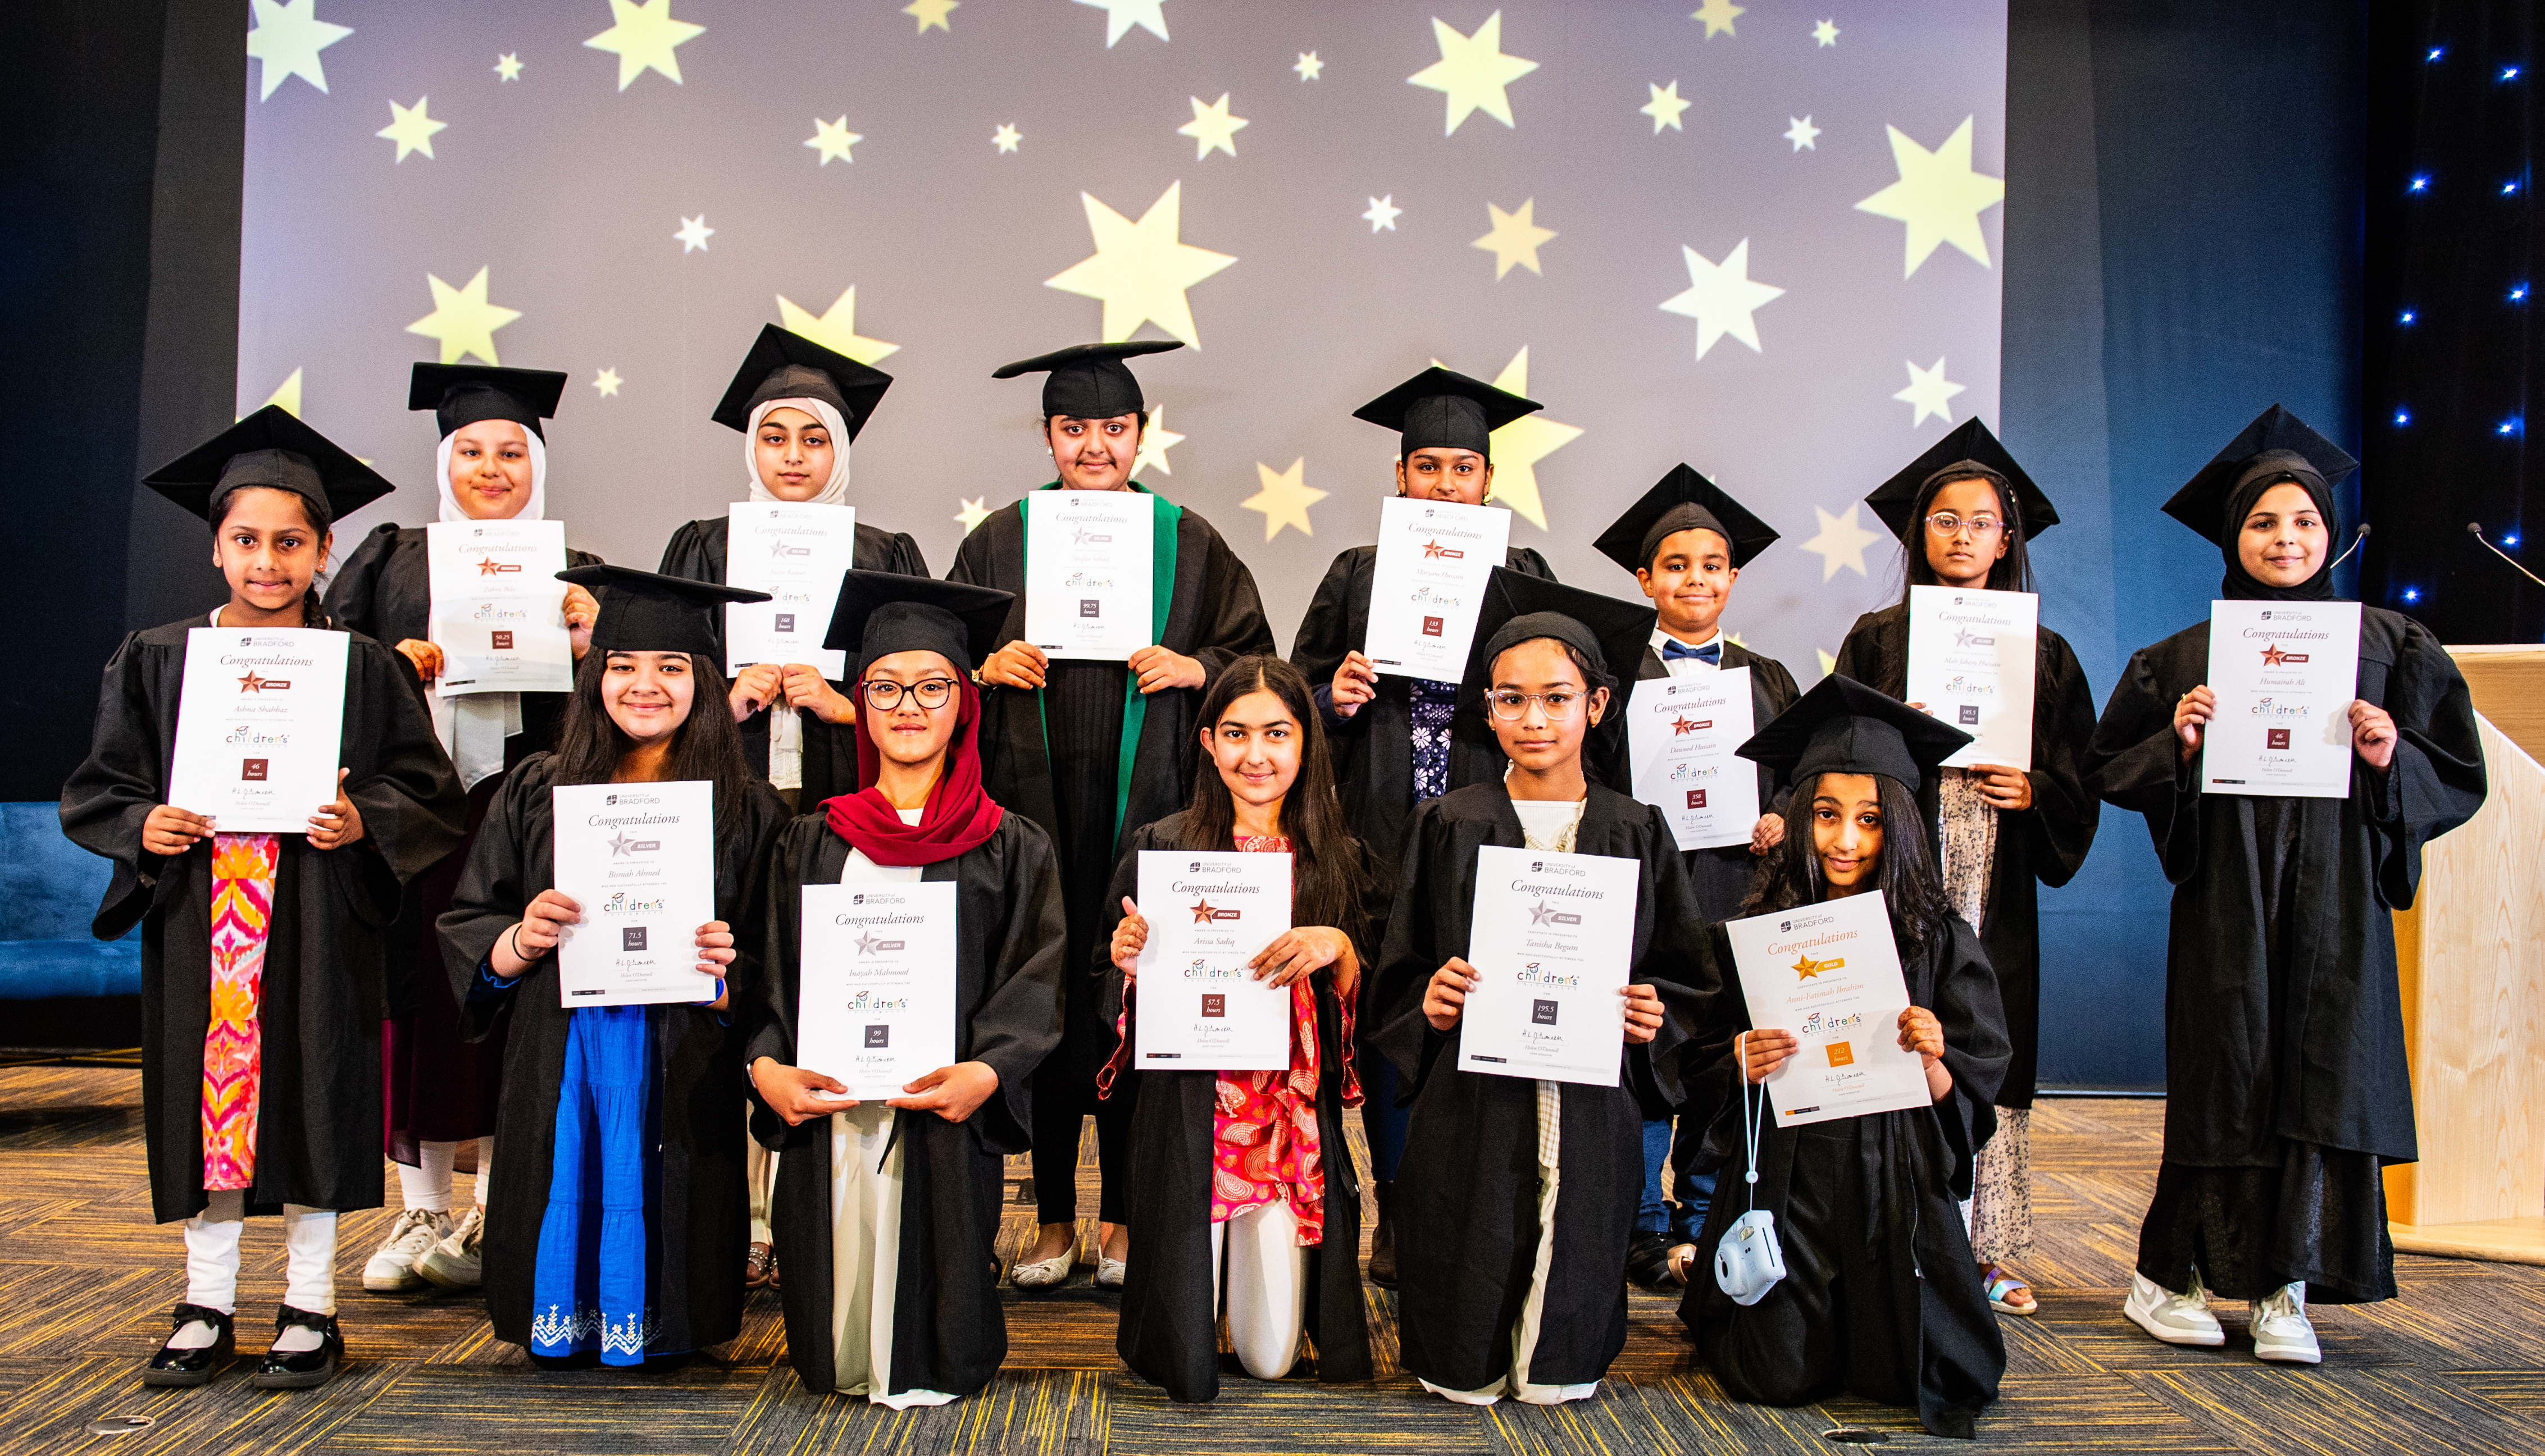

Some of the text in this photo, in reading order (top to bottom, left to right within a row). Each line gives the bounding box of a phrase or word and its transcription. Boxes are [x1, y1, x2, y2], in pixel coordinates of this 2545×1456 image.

[1057, 513, 1127, 524] Congratulations
[755, 526, 827, 537] Congratulations
[1409, 523, 1481, 539] Congratulations
[459, 542, 536, 555] Congratulations
[1415, 569, 1440, 578] Maryam
[1066, 578, 1113, 587] children's
[771, 590, 809, 601] ildren's
[1412, 591, 1459, 606] children's
[475, 608, 526, 618] children's
[1940, 612, 2011, 625] Congratulations
[2243, 628, 2329, 641] Congratulations
[221, 654, 313, 668] Congratulations
[1678, 684, 1710, 694] BRADFORD
[1946, 681, 1993, 693] children's
[1655, 698, 1725, 714] Congratulations
[2252, 704, 2307, 714] children's
[226, 732, 288, 743] children's
[1670, 767, 1718, 779] children's
[589, 813, 680, 829] Congratulations
[608, 868, 661, 878] Bismah Ahmed
[1545, 867, 1585, 877] BRADFORD
[1172, 882, 1260, 896] Congratulations
[1511, 880, 1604, 899] Congratulations
[604, 899, 662, 911] children's
[836, 912, 924, 928] Congratulations
[1792, 915, 1833, 930] BRADFORD
[1215, 938, 1235, 947] Sadiq
[1527, 939, 1578, 952] Tanisha Begum
[1768, 928, 1857, 955] Congratulations
[849, 969, 872, 978] Inayah
[1185, 966, 1241, 977] children's
[1517, 970, 1577, 985] children's
[1786, 984, 1863, 1004] Anni-Fatimah Ibrahim
[848, 997, 906, 1009] children's
[1802, 1014, 1861, 1033] children's
